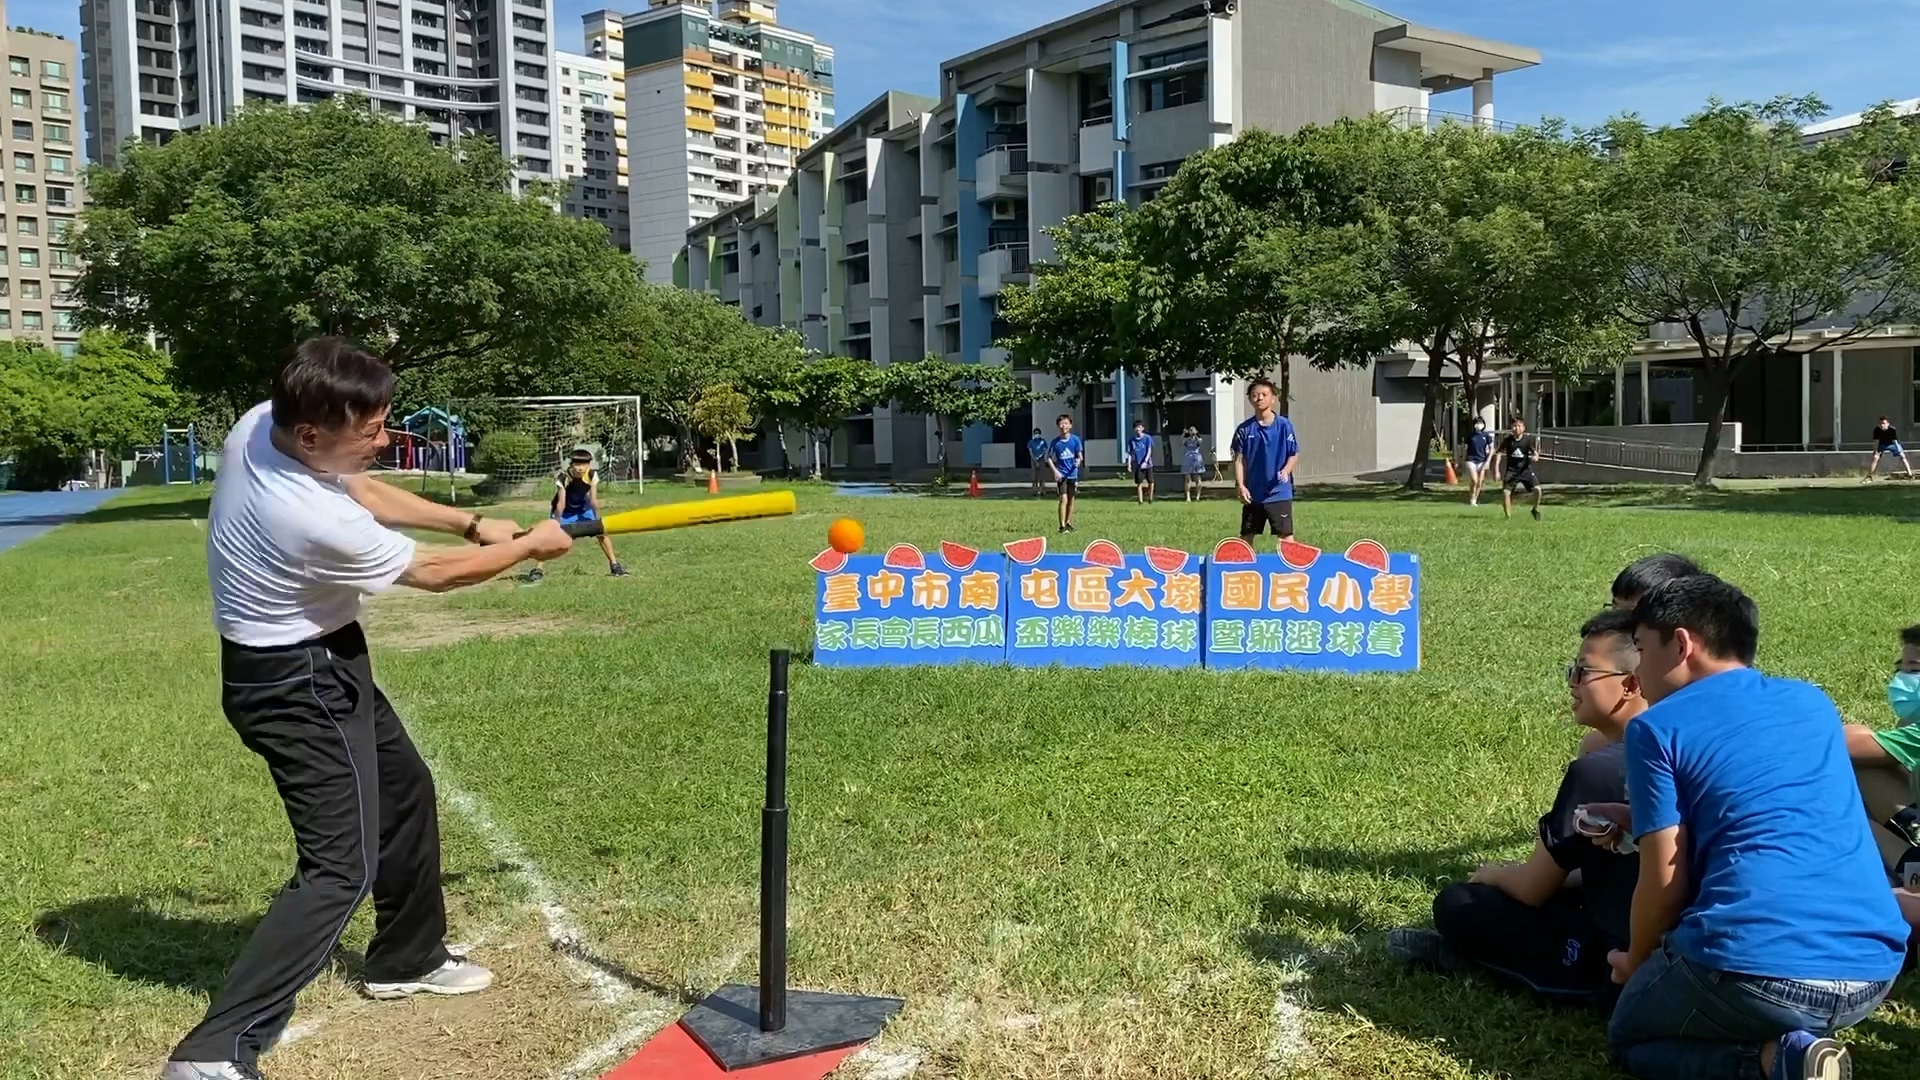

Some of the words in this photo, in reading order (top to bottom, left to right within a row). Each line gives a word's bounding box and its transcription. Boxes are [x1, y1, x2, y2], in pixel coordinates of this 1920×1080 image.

[822, 566, 1414, 615] 臺中市南屯區大墩國民小學
[816, 614, 1406, 658] 家長會長西瓜盃樂樂棒球暨躲避球賽
